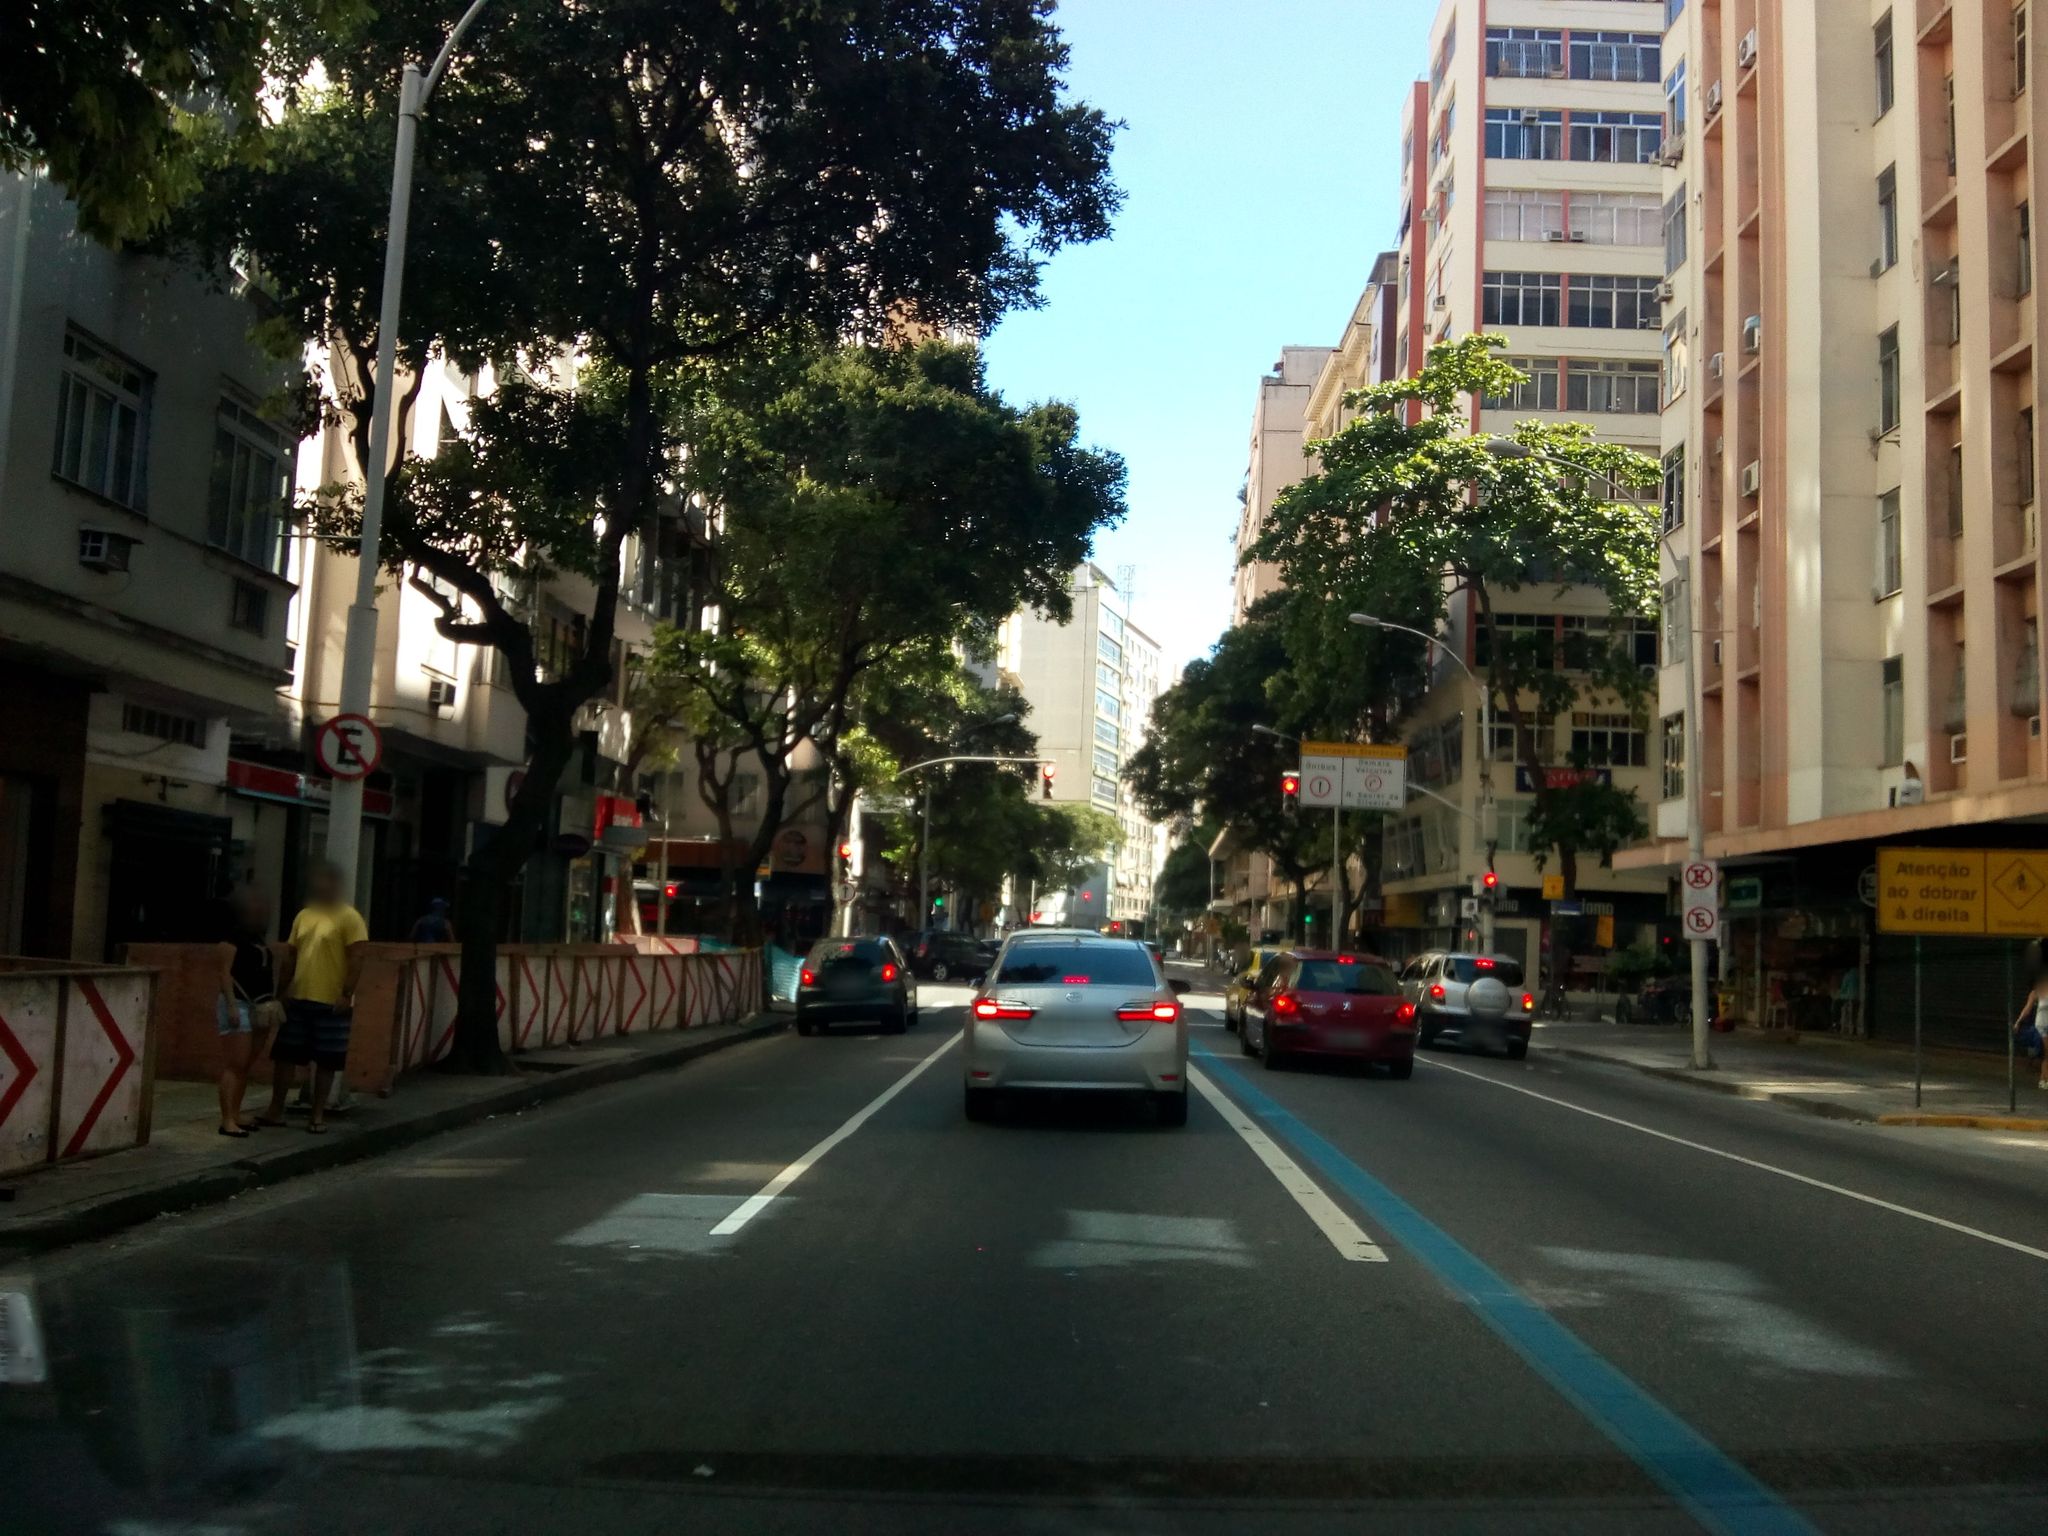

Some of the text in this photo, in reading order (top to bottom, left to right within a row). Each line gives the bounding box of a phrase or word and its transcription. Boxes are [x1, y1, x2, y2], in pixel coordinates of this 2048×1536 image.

[1895, 861, 1971, 880] Atenção
[1887, 885, 1978, 901] ao dobrar
[1895, 906, 1970, 922] à direita
